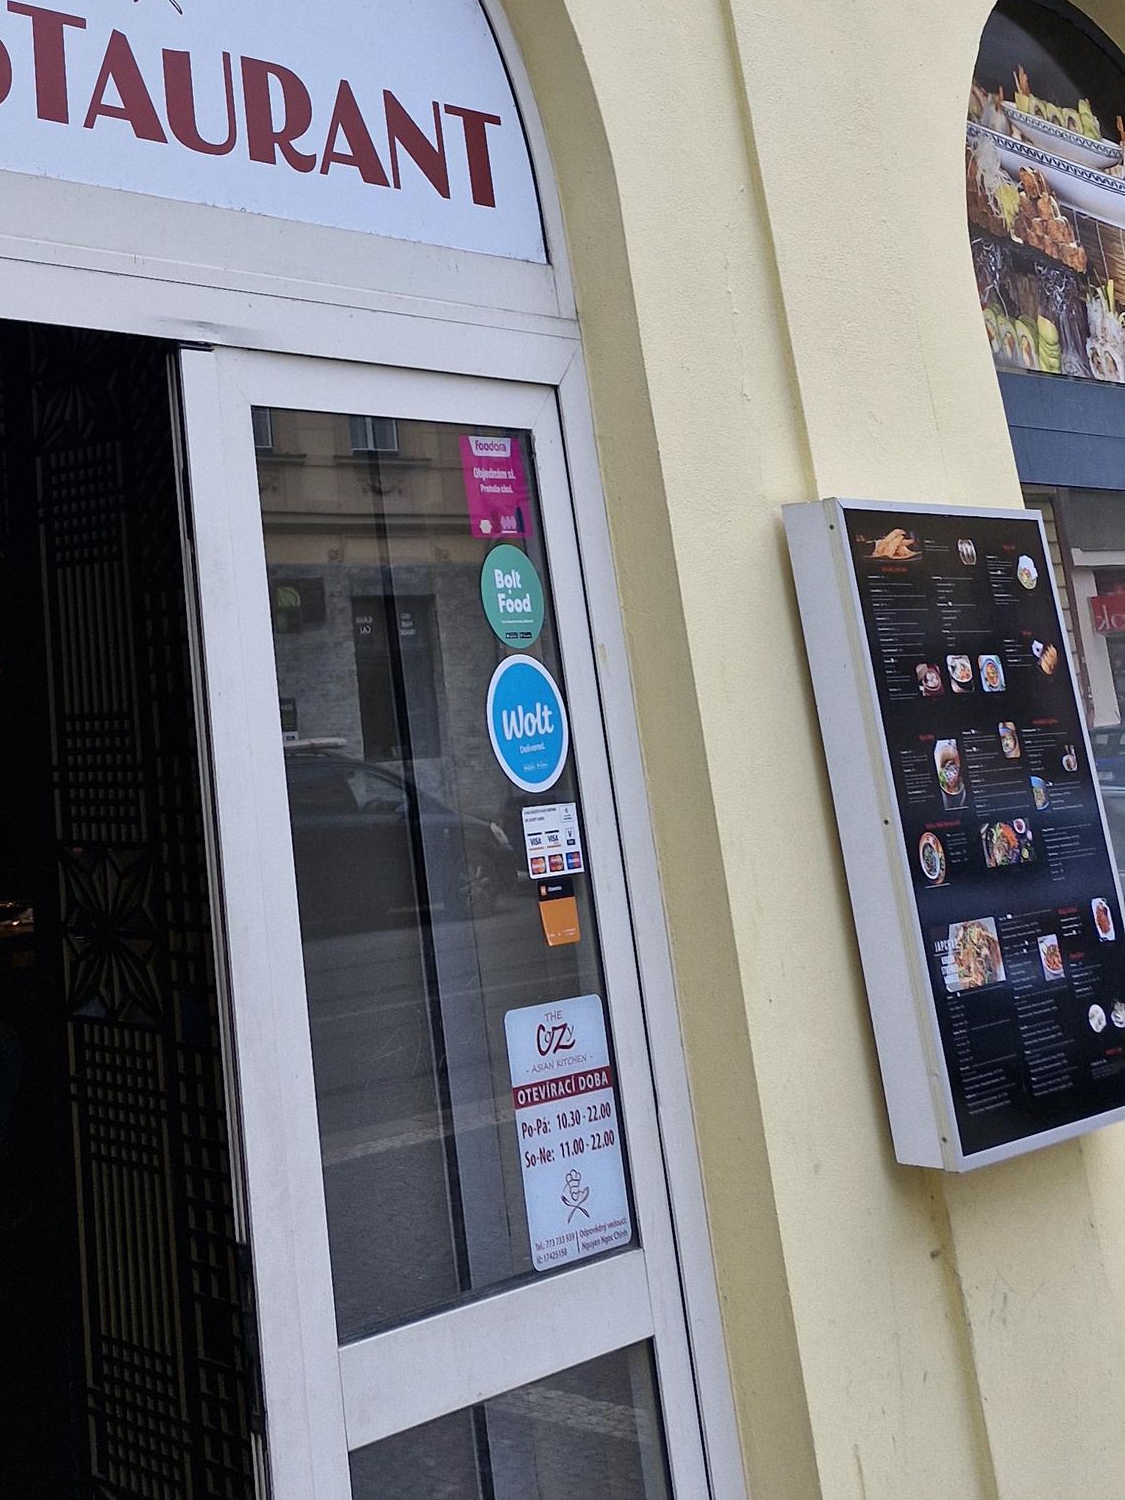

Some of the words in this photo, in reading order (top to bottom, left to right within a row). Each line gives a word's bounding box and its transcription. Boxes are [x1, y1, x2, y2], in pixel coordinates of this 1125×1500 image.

[475, 440, 507, 453] foodora
[495, 569, 522, 590] Bolt
[498, 593, 532, 613] Food
[502, 702, 554, 740] Wolt
[530, 837, 542, 846] VISA
[548, 834, 559, 842] VISA
[545, 1011, 563, 1022] THE
[531, 1061, 554, 1073] ASIAN
[557, 1054, 587, 1067] KITCHEN
[517, 1078, 575, 1104] OTEVÍRACÍ
[579, 1072, 609, 1088] DOBA
[522, 1116, 551, 1139] Po-Pá:
[557, 1110, 581, 1130] 10.30
[587, 1102, 611, 1123] 22.00
[525, 1147, 555, 1168] So-Ne:
[560, 1138, 584, 1158] 11.00
[592, 1130, 614, 1150] 22.00
